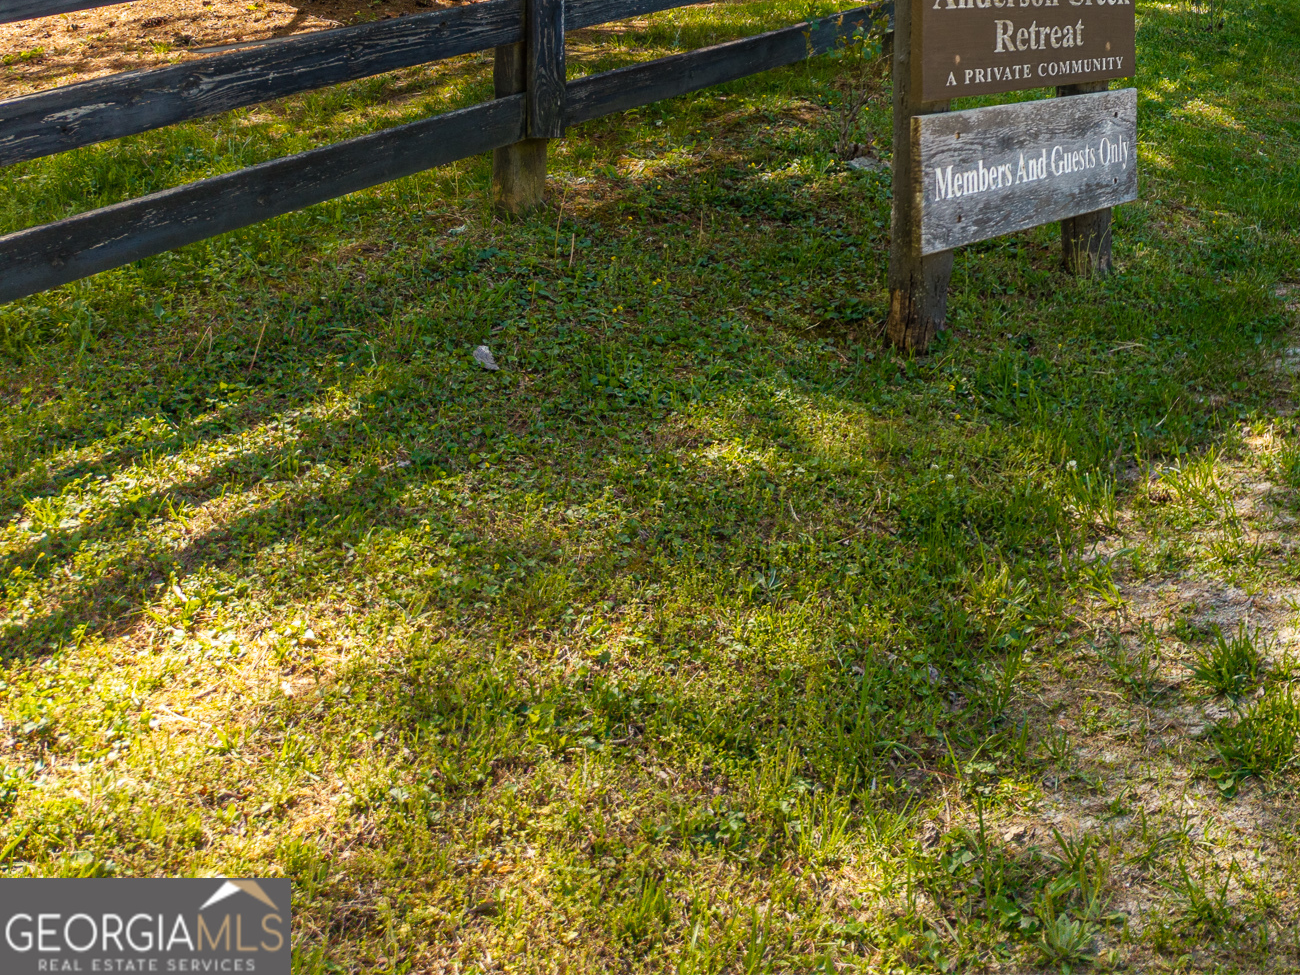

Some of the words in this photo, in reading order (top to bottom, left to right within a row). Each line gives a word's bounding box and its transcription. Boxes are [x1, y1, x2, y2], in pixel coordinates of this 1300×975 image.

[993, 18, 1085, 54] Retreat
[945, 72, 958, 87] A
[964, 64, 1033, 84] PRIVATE
[1038, 56, 1124, 76] COMMUNITY
[934, 159, 1012, 202] Members
[1015, 148, 1048, 185] And
[1051, 143, 1096, 175] Guests
[1100, 134, 1130, 169] Only
